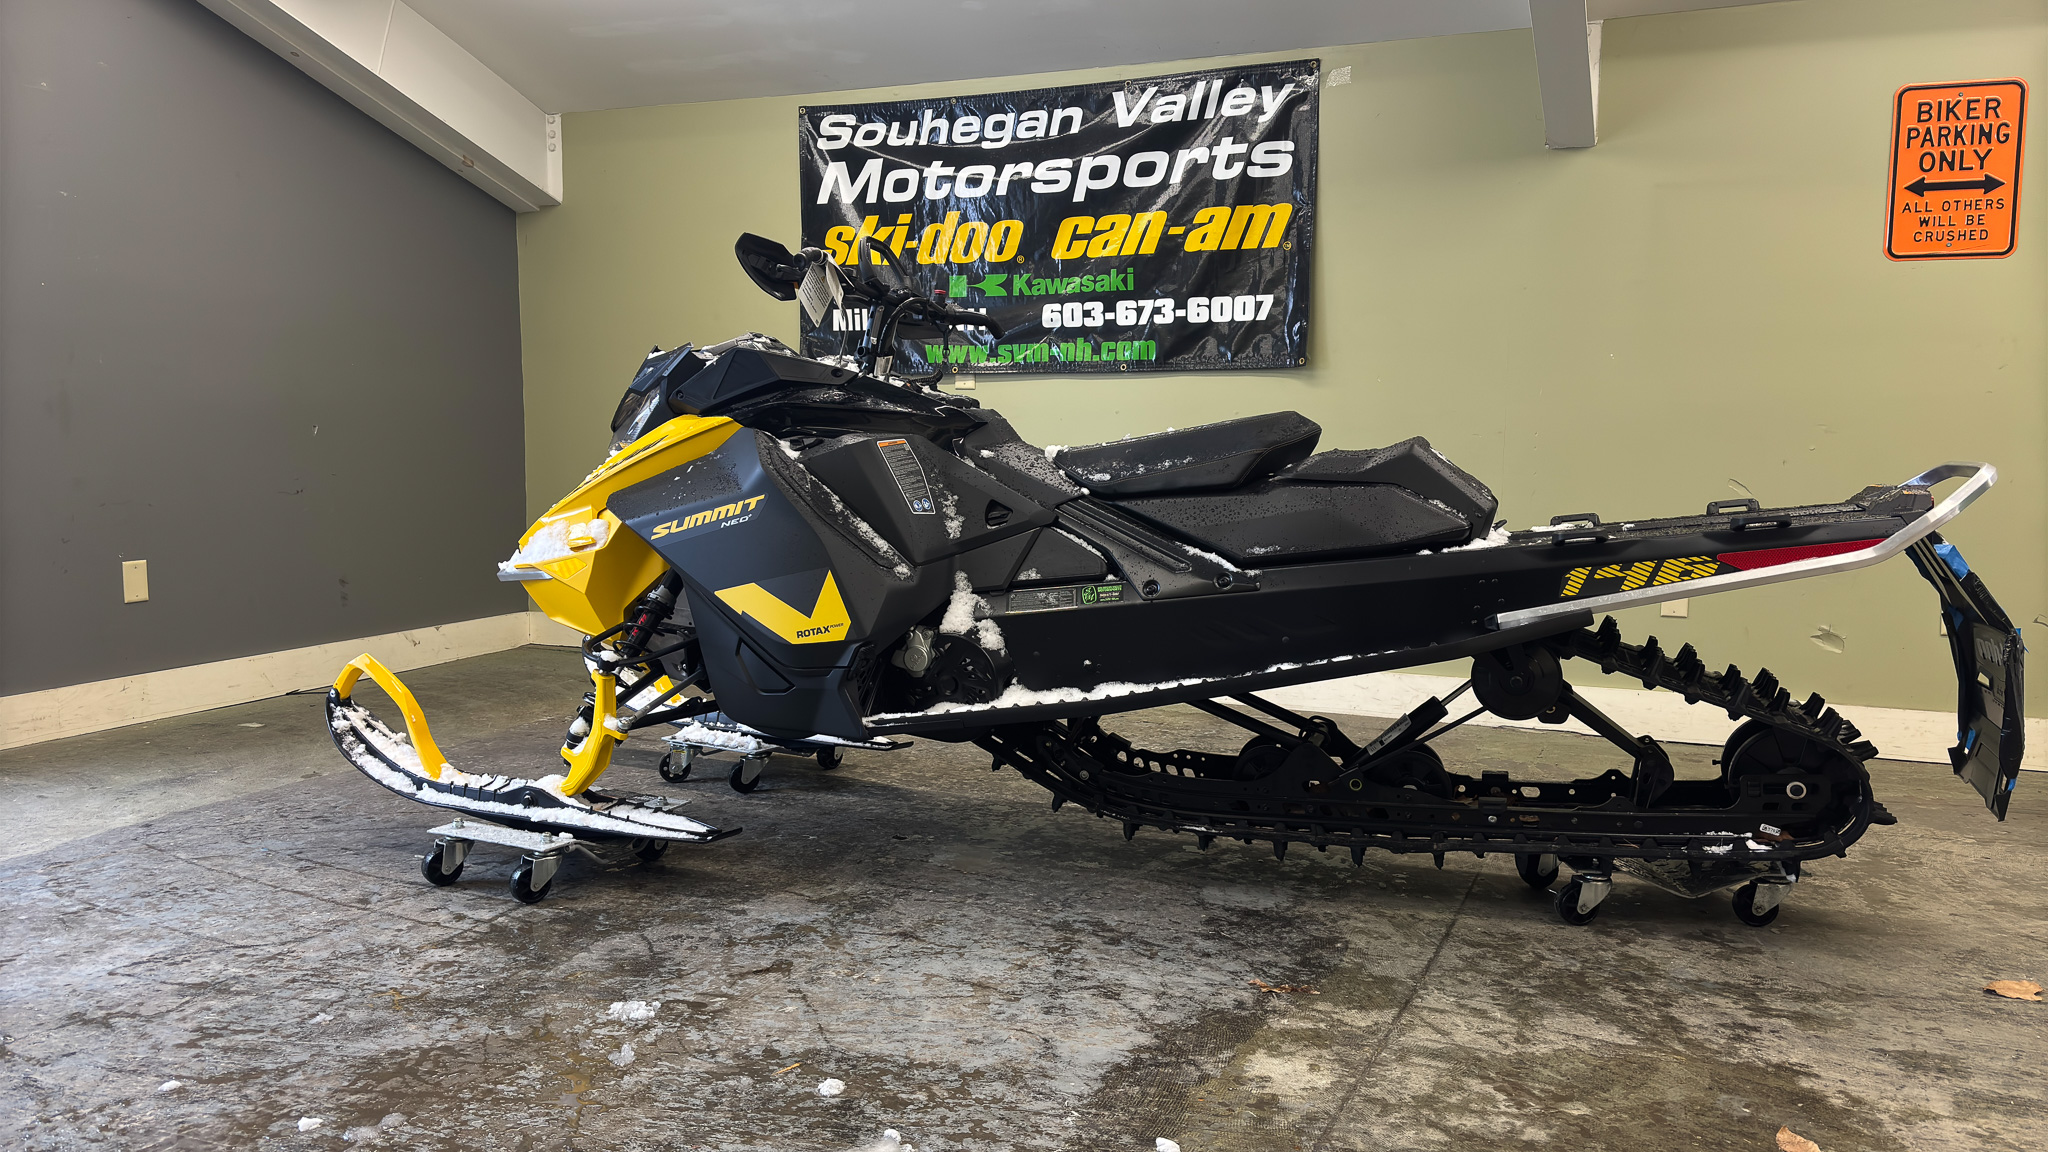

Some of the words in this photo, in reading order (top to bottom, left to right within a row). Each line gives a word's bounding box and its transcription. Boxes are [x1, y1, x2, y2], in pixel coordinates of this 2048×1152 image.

[817, 105, 1084, 150] Souhegan
[1111, 77, 1296, 127] Valley
[1917, 98, 2001, 123] BIKER
[1906, 121, 2010, 149] PARKING
[816, 136, 1294, 205] Motorsports
[1918, 148, 1993, 173] ONLY
[1901, 201, 1933, 214] ALL
[1941, 198, 2005, 212] OTHERS
[1918, 215, 1956, 228] WILL
[1966, 213, 1986, 226] BE
[825, 212, 1024, 265] ski-doo
[1050, 202, 1293, 261] can-am
[1913, 229, 1989, 243] CRUSHED
[1012, 267, 1134, 297] Kawasaki
[1041, 294, 1275, 329] 603-673-6007
[925, 337, 1157, 364] www.svm-nh.com
[650, 494, 766, 541] SUMMIT
[1560, 555, 1721, 597] 146
